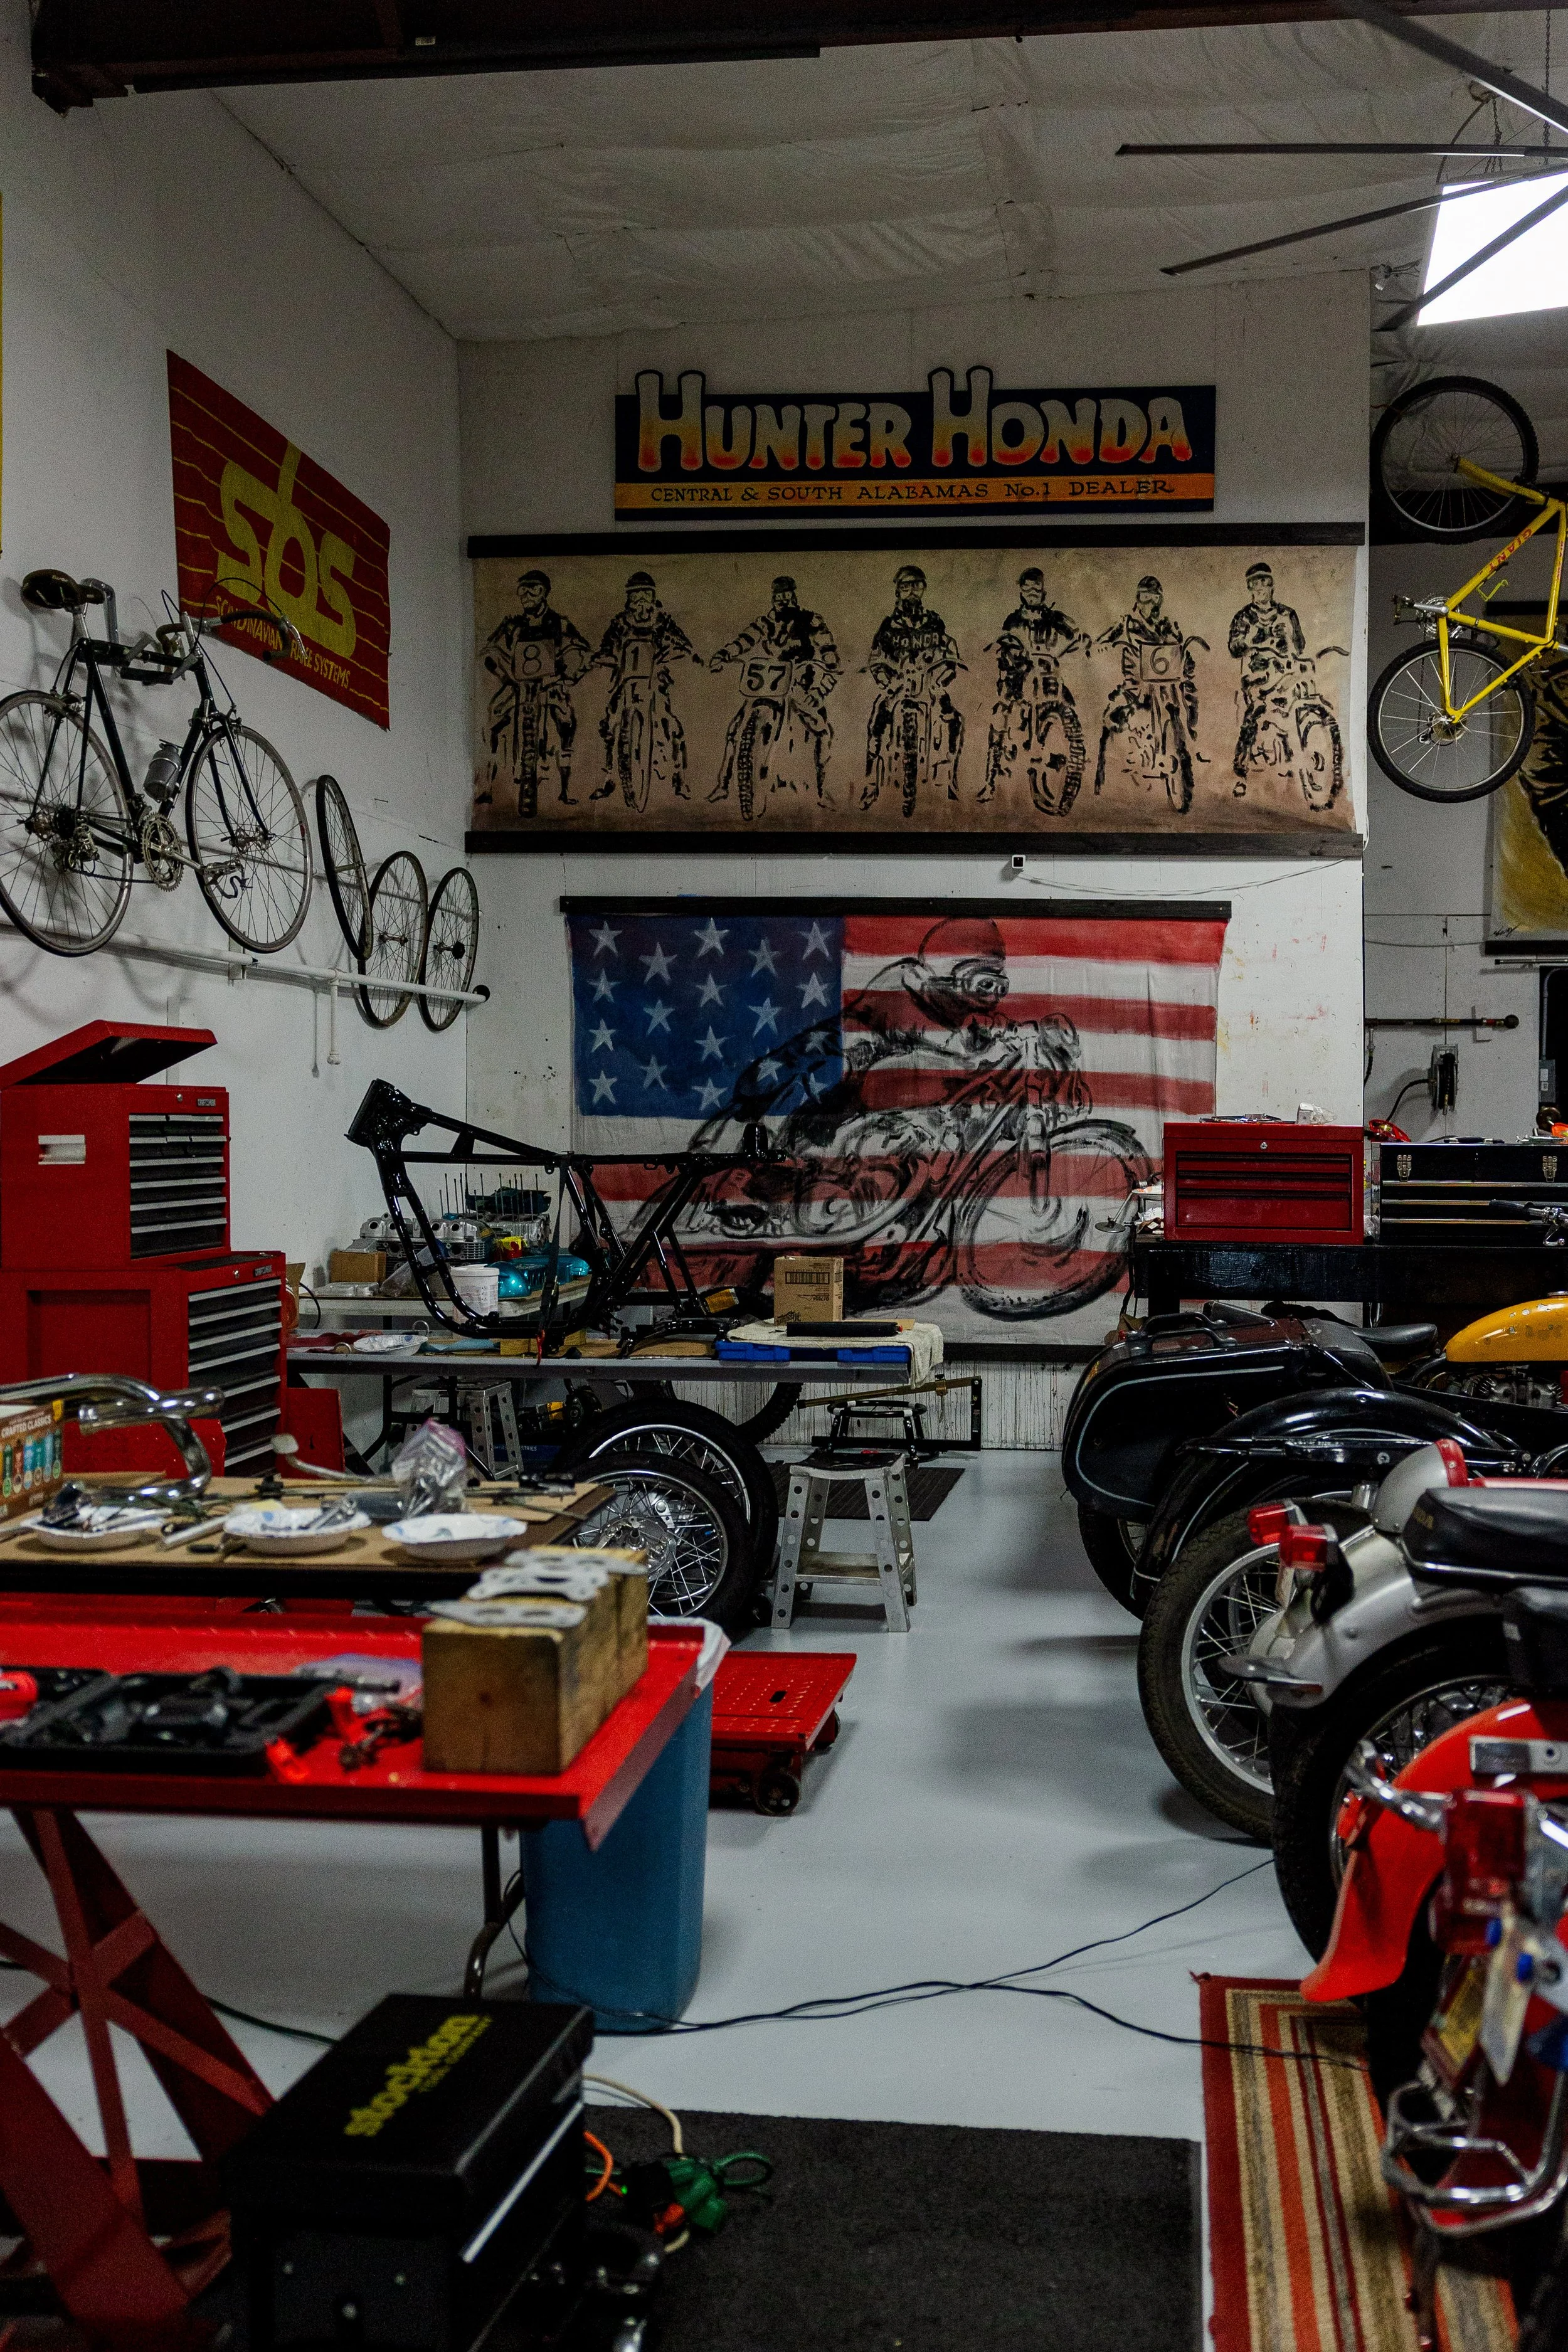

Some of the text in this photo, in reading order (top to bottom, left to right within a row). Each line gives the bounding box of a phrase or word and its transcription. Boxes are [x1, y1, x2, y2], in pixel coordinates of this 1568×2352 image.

[635, 366, 1194, 474] HUNTER HONDA
[650, 487, 733, 502] CENTRAL
[741, 487, 760, 501] &
[767, 485, 842, 501] SOUTH
[857, 484, 989, 500] ALABAMAS
[1068, 480, 1175, 496] DEALER
[893, 632, 940, 649] HONDA
[290, 639, 313, 669] RAKE
[314, 653, 351, 689] SYSTEMS
[522, 644, 542, 676] 8
[631, 646, 640, 671] 1
[1150, 647, 1170, 675] 6
[746, 663, 787, 691] 57
